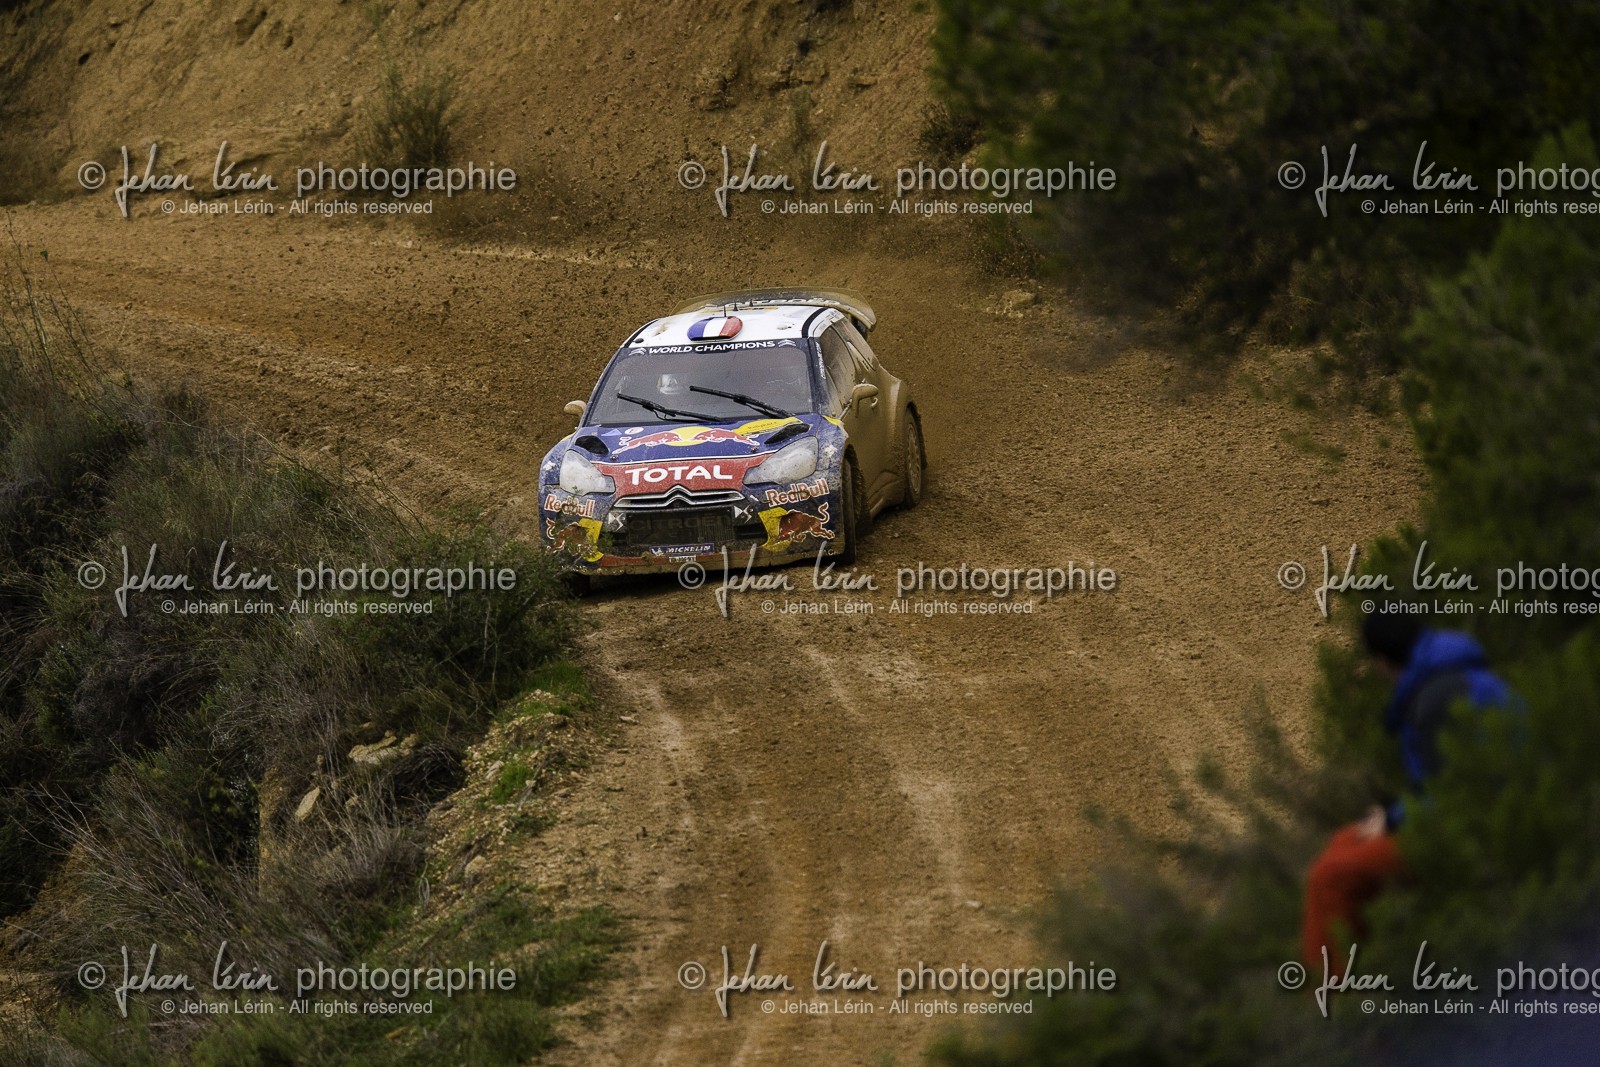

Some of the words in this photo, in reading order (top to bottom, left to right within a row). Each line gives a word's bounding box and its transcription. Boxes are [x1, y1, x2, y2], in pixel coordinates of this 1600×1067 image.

[649, 345, 693, 354] WORLD
[697, 340, 776, 352] CHAMPIONS
[625, 465, 733, 486] TOTAL
[666, 545, 711, 554] MICHELIN
